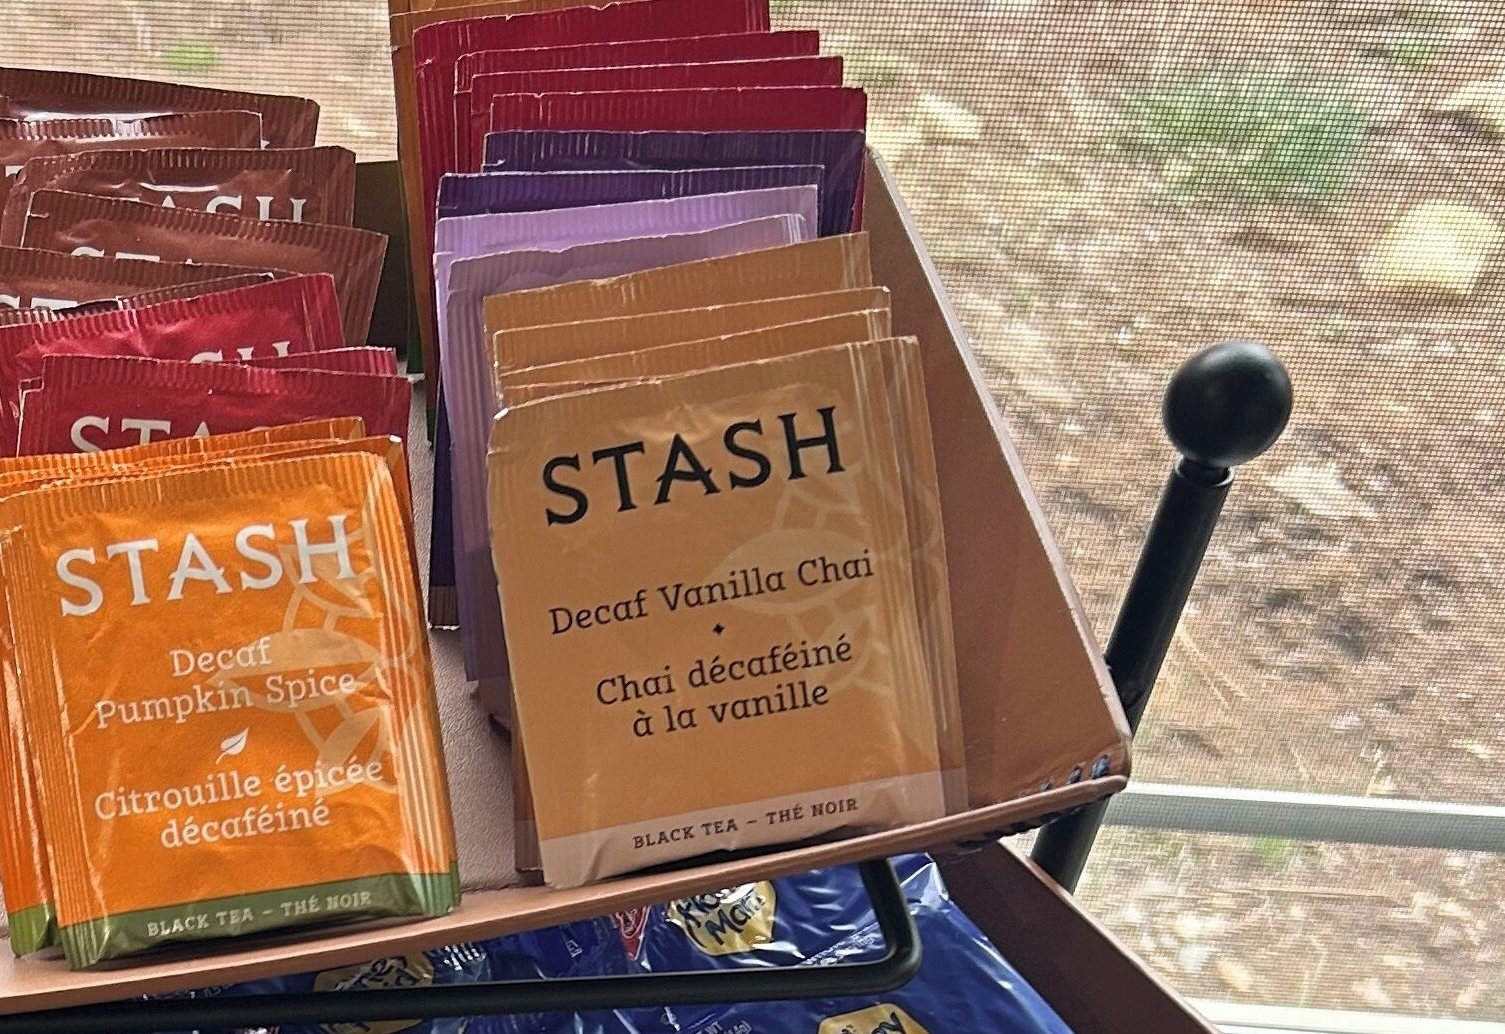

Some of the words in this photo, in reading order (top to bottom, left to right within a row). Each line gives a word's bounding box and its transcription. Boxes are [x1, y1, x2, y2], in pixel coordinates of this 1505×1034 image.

[542, 406, 846, 527] STASH
[54, 514, 359, 617] STASH
[549, 588, 649, 634] Decaf
[656, 568, 787, 614] Vanilla
[797, 549, 875, 588] Chai
[170, 636, 272, 678] Decaf
[596, 664, 676, 706] Chai
[687, 633, 853, 689] décaféiné
[96, 684, 255, 729] Pumpkin
[265, 670, 358, 711] Spice
[632, 710, 654, 739] à
[665, 703, 697, 732] la
[708, 682, 831, 723] vanille
[94, 769, 260, 820] Citrouille
[275, 757, 383, 793] épicée
[161, 800, 330, 849] décaféiné
[633, 829, 694, 850] BLACK
[701, 819, 739, 836] TEA
[766, 803, 803, 826] THÉ
[811, 798, 859, 817] NOIR
[146, 911, 209, 938] BLACK
[216, 907, 254, 924] TEA
[280, 895, 320, 918] THÉ
